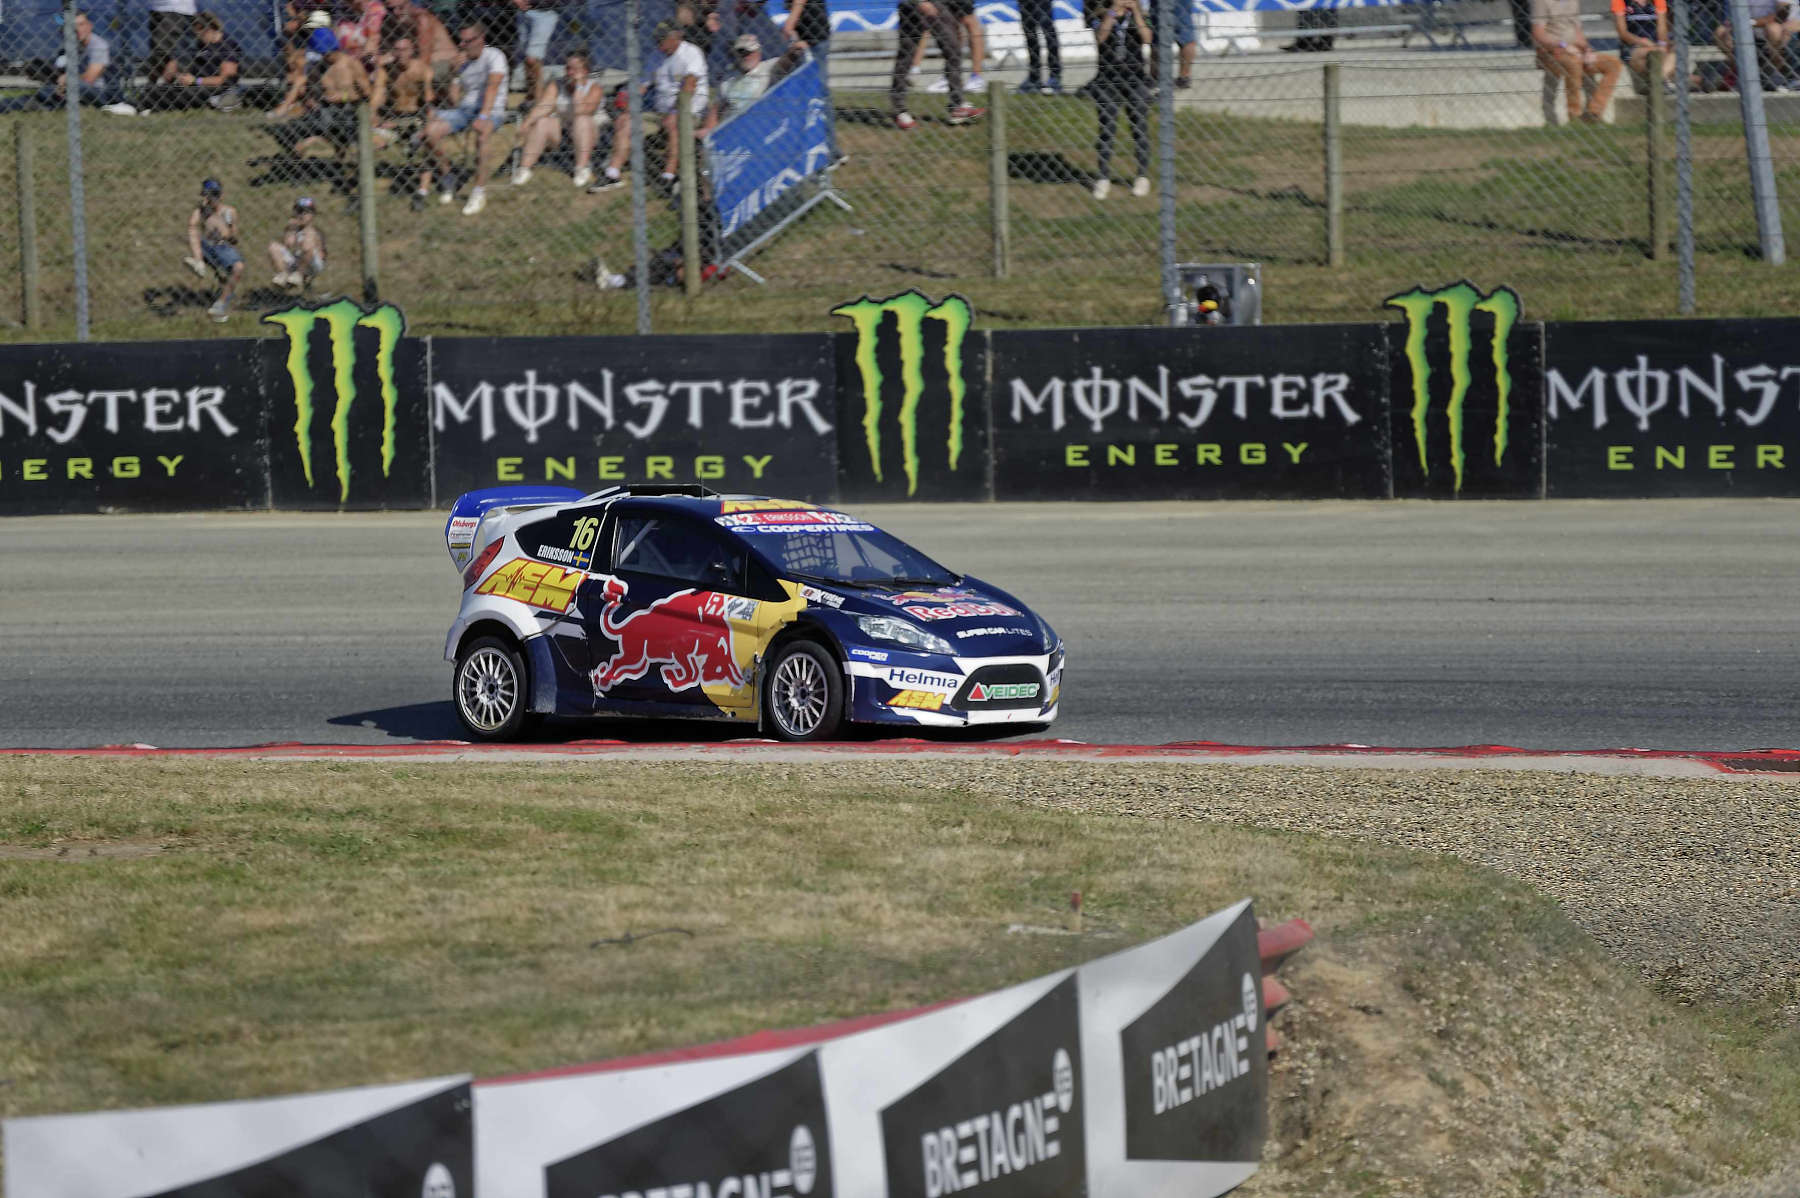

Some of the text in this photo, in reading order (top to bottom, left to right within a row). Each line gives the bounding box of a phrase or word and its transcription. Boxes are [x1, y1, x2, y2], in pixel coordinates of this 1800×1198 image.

[1066, 442, 1309, 466] ENERGY
[1608, 444, 1785, 470] ENER
[0, 455, 184, 480] ERGY
[497, 455, 773, 480] ENERGY
[569, 516, 599, 550] 16
[537, 545, 575, 564] ERIKSSON
[889, 669, 957, 689] Helmia
[983, 684, 1038, 699] VEIDEC
[886, 690, 946, 711] AEM
[1152, 1013, 1249, 1115] BRETAGNE
[921, 1091, 1061, 1198] BRETAGNE
